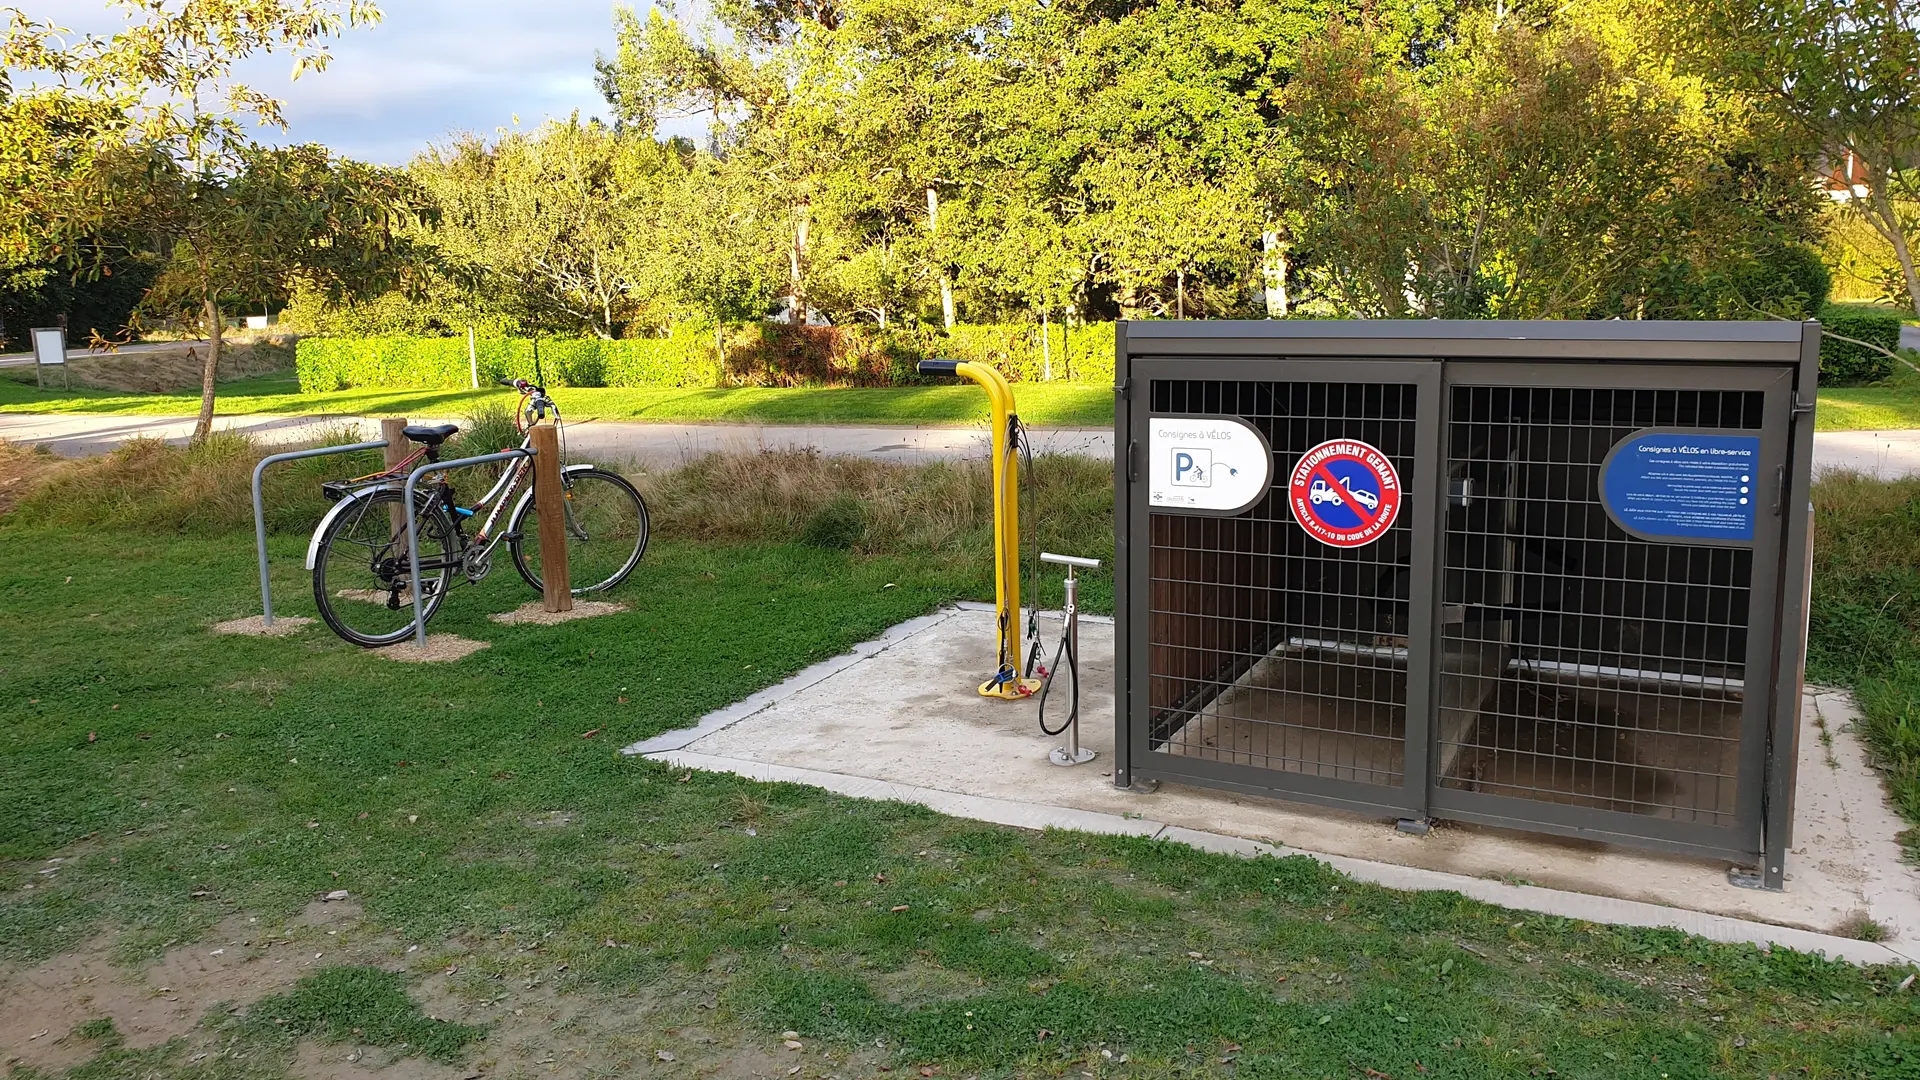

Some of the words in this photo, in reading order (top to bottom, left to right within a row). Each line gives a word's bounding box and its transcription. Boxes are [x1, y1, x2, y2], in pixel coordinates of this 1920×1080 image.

[1158, 429, 1197, 440] Consignes
[1206, 429, 1232, 440] VÉLOS
[1638, 444, 1671, 454] Consignes
[1678, 445, 1699, 454] VÉLOS
[1710, 447, 1751, 456] libre-service
[1176, 452, 1193, 481] P
[1294, 444, 1367, 487] STATIONNEMENT
[1366, 452, 1396, 490] GENANT
[1296, 498, 1312, 522] ARTICLE
[1308, 520, 1335, 540] R.417-10
[1347, 531, 1364, 541] CODE
[1364, 526, 1374, 536] DE
[1371, 520, 1382, 531] LA
[1377, 503, 1392, 526] ROUTE
